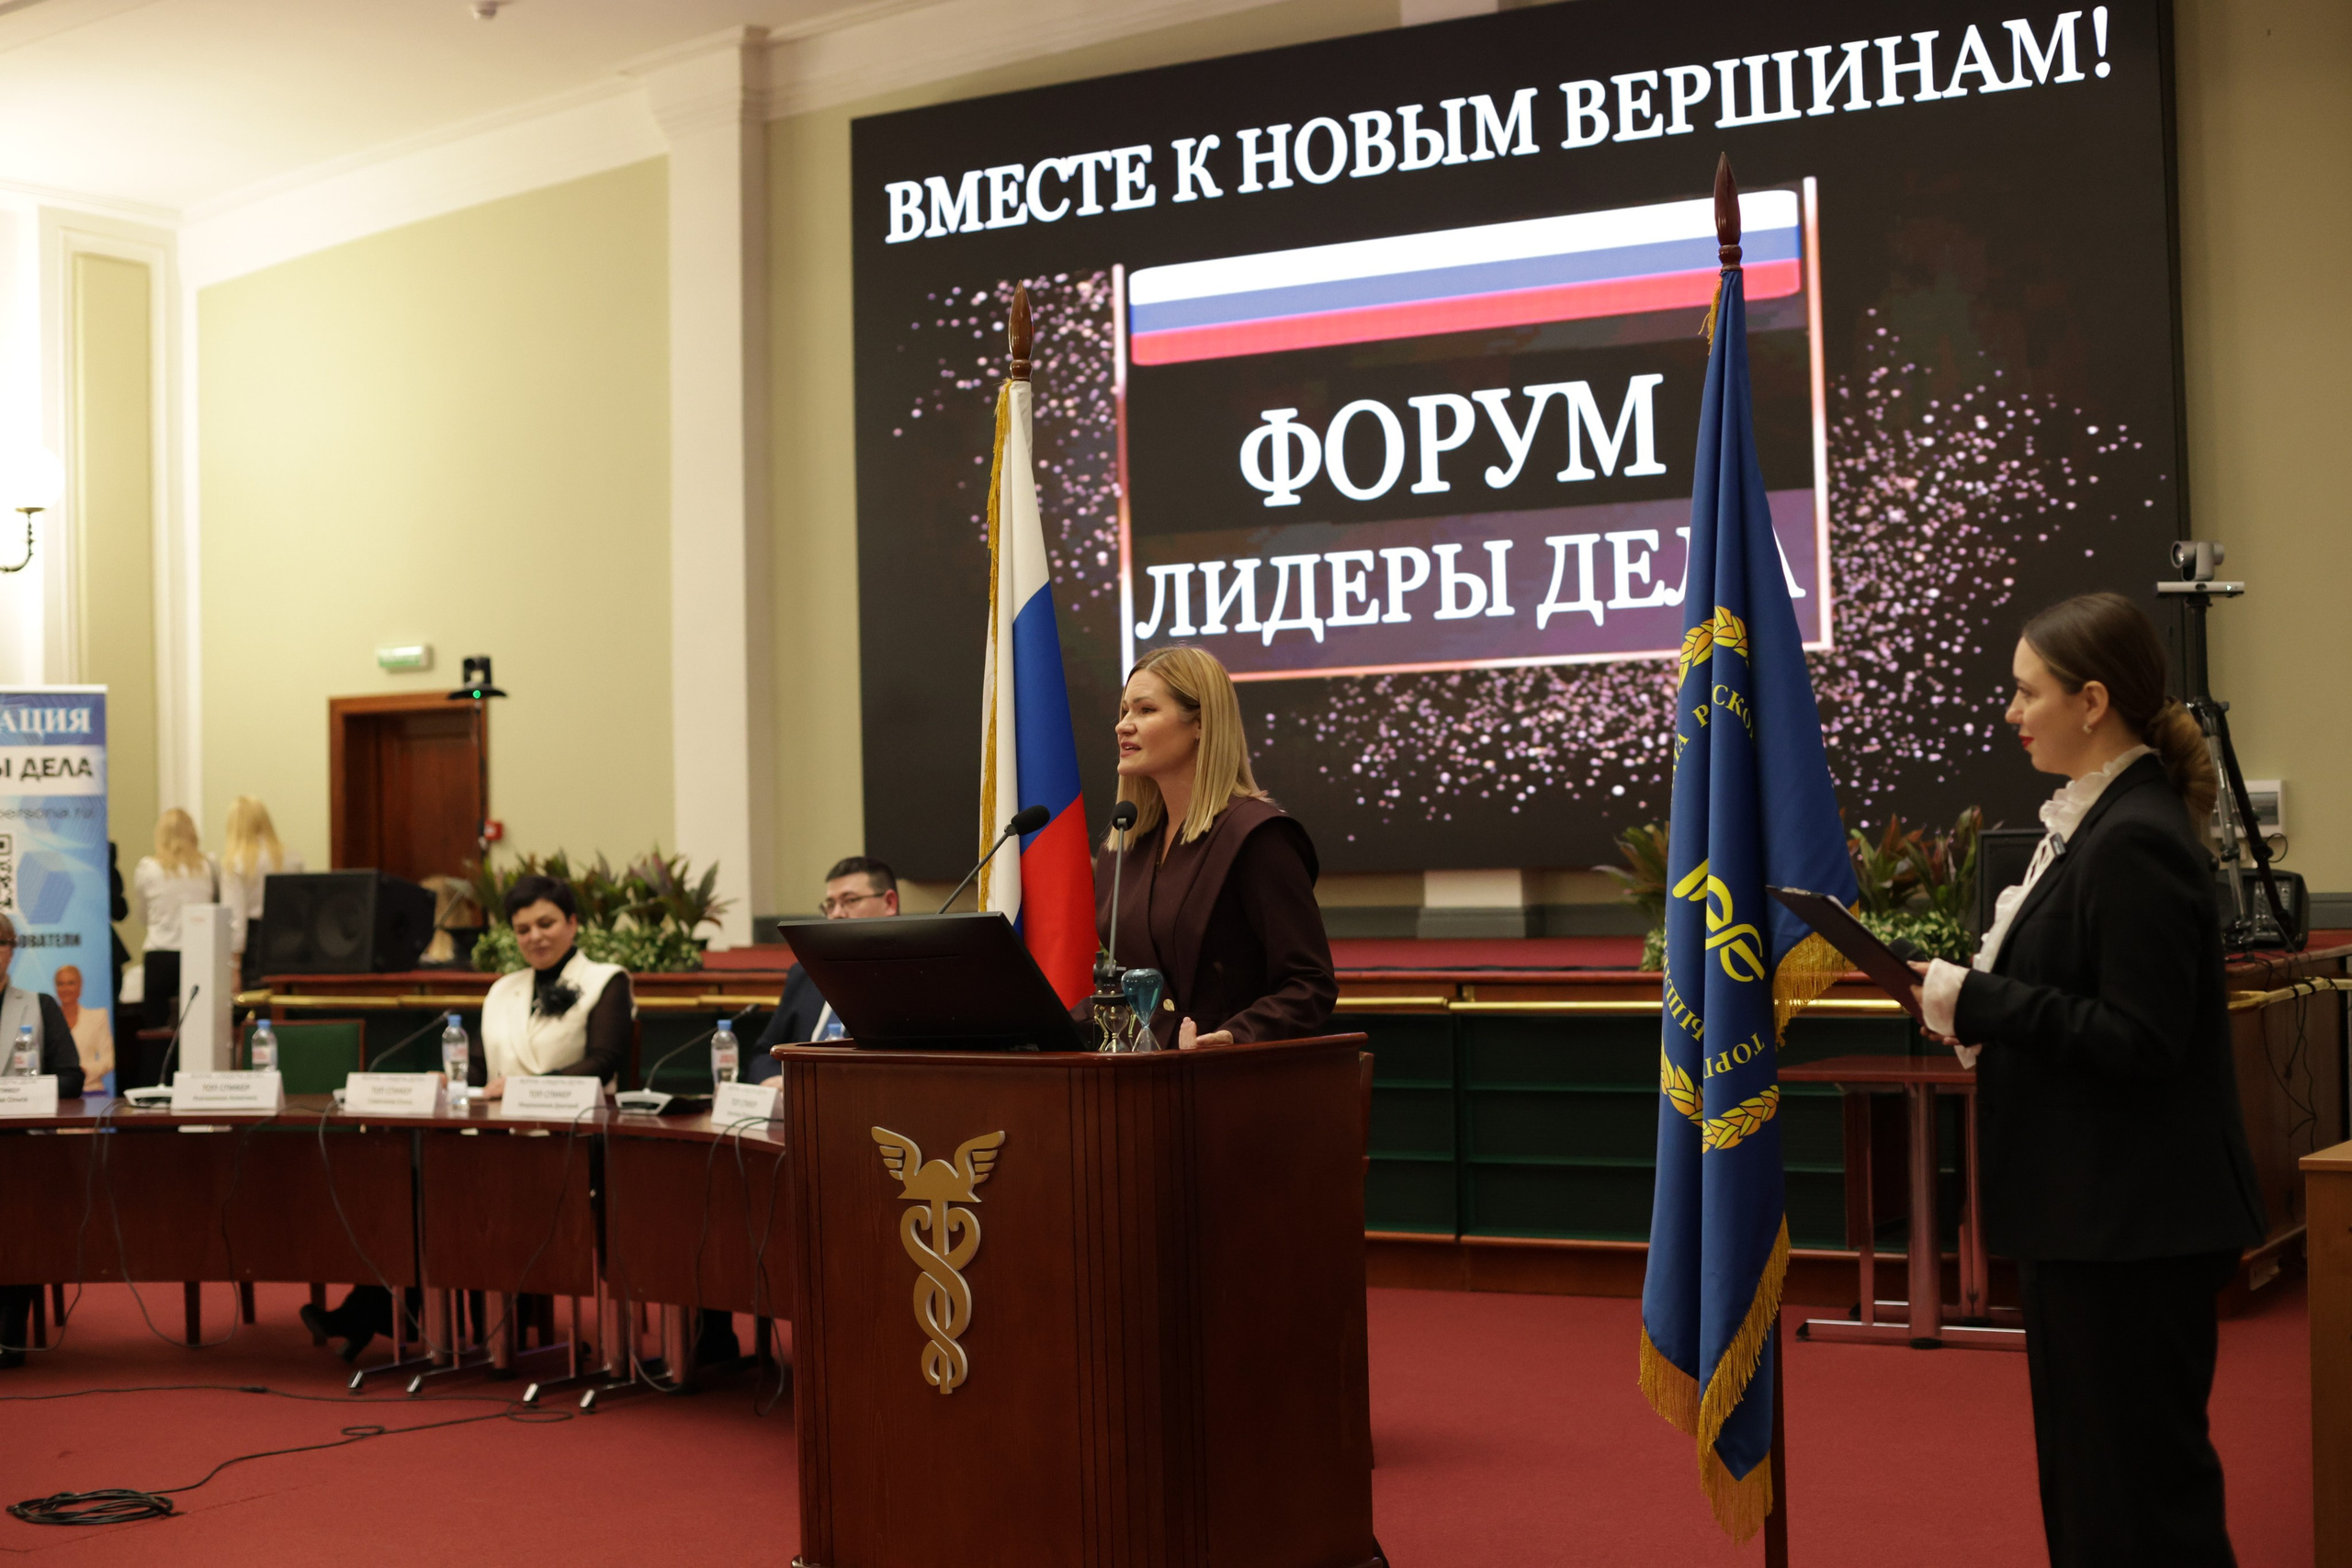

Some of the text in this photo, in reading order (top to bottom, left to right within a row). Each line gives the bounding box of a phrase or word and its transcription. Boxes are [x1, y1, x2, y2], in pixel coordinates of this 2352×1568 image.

[884, 6, 2112, 244] ВМЕСТЕ К НОВЫМ ВЕРШИНАМ!
[1239, 372, 1667, 507] ФОРУМ
[1134, 538, 1516, 647] ЛИДЕРЫ
[20, 757, 94, 782] ДЕЛА
